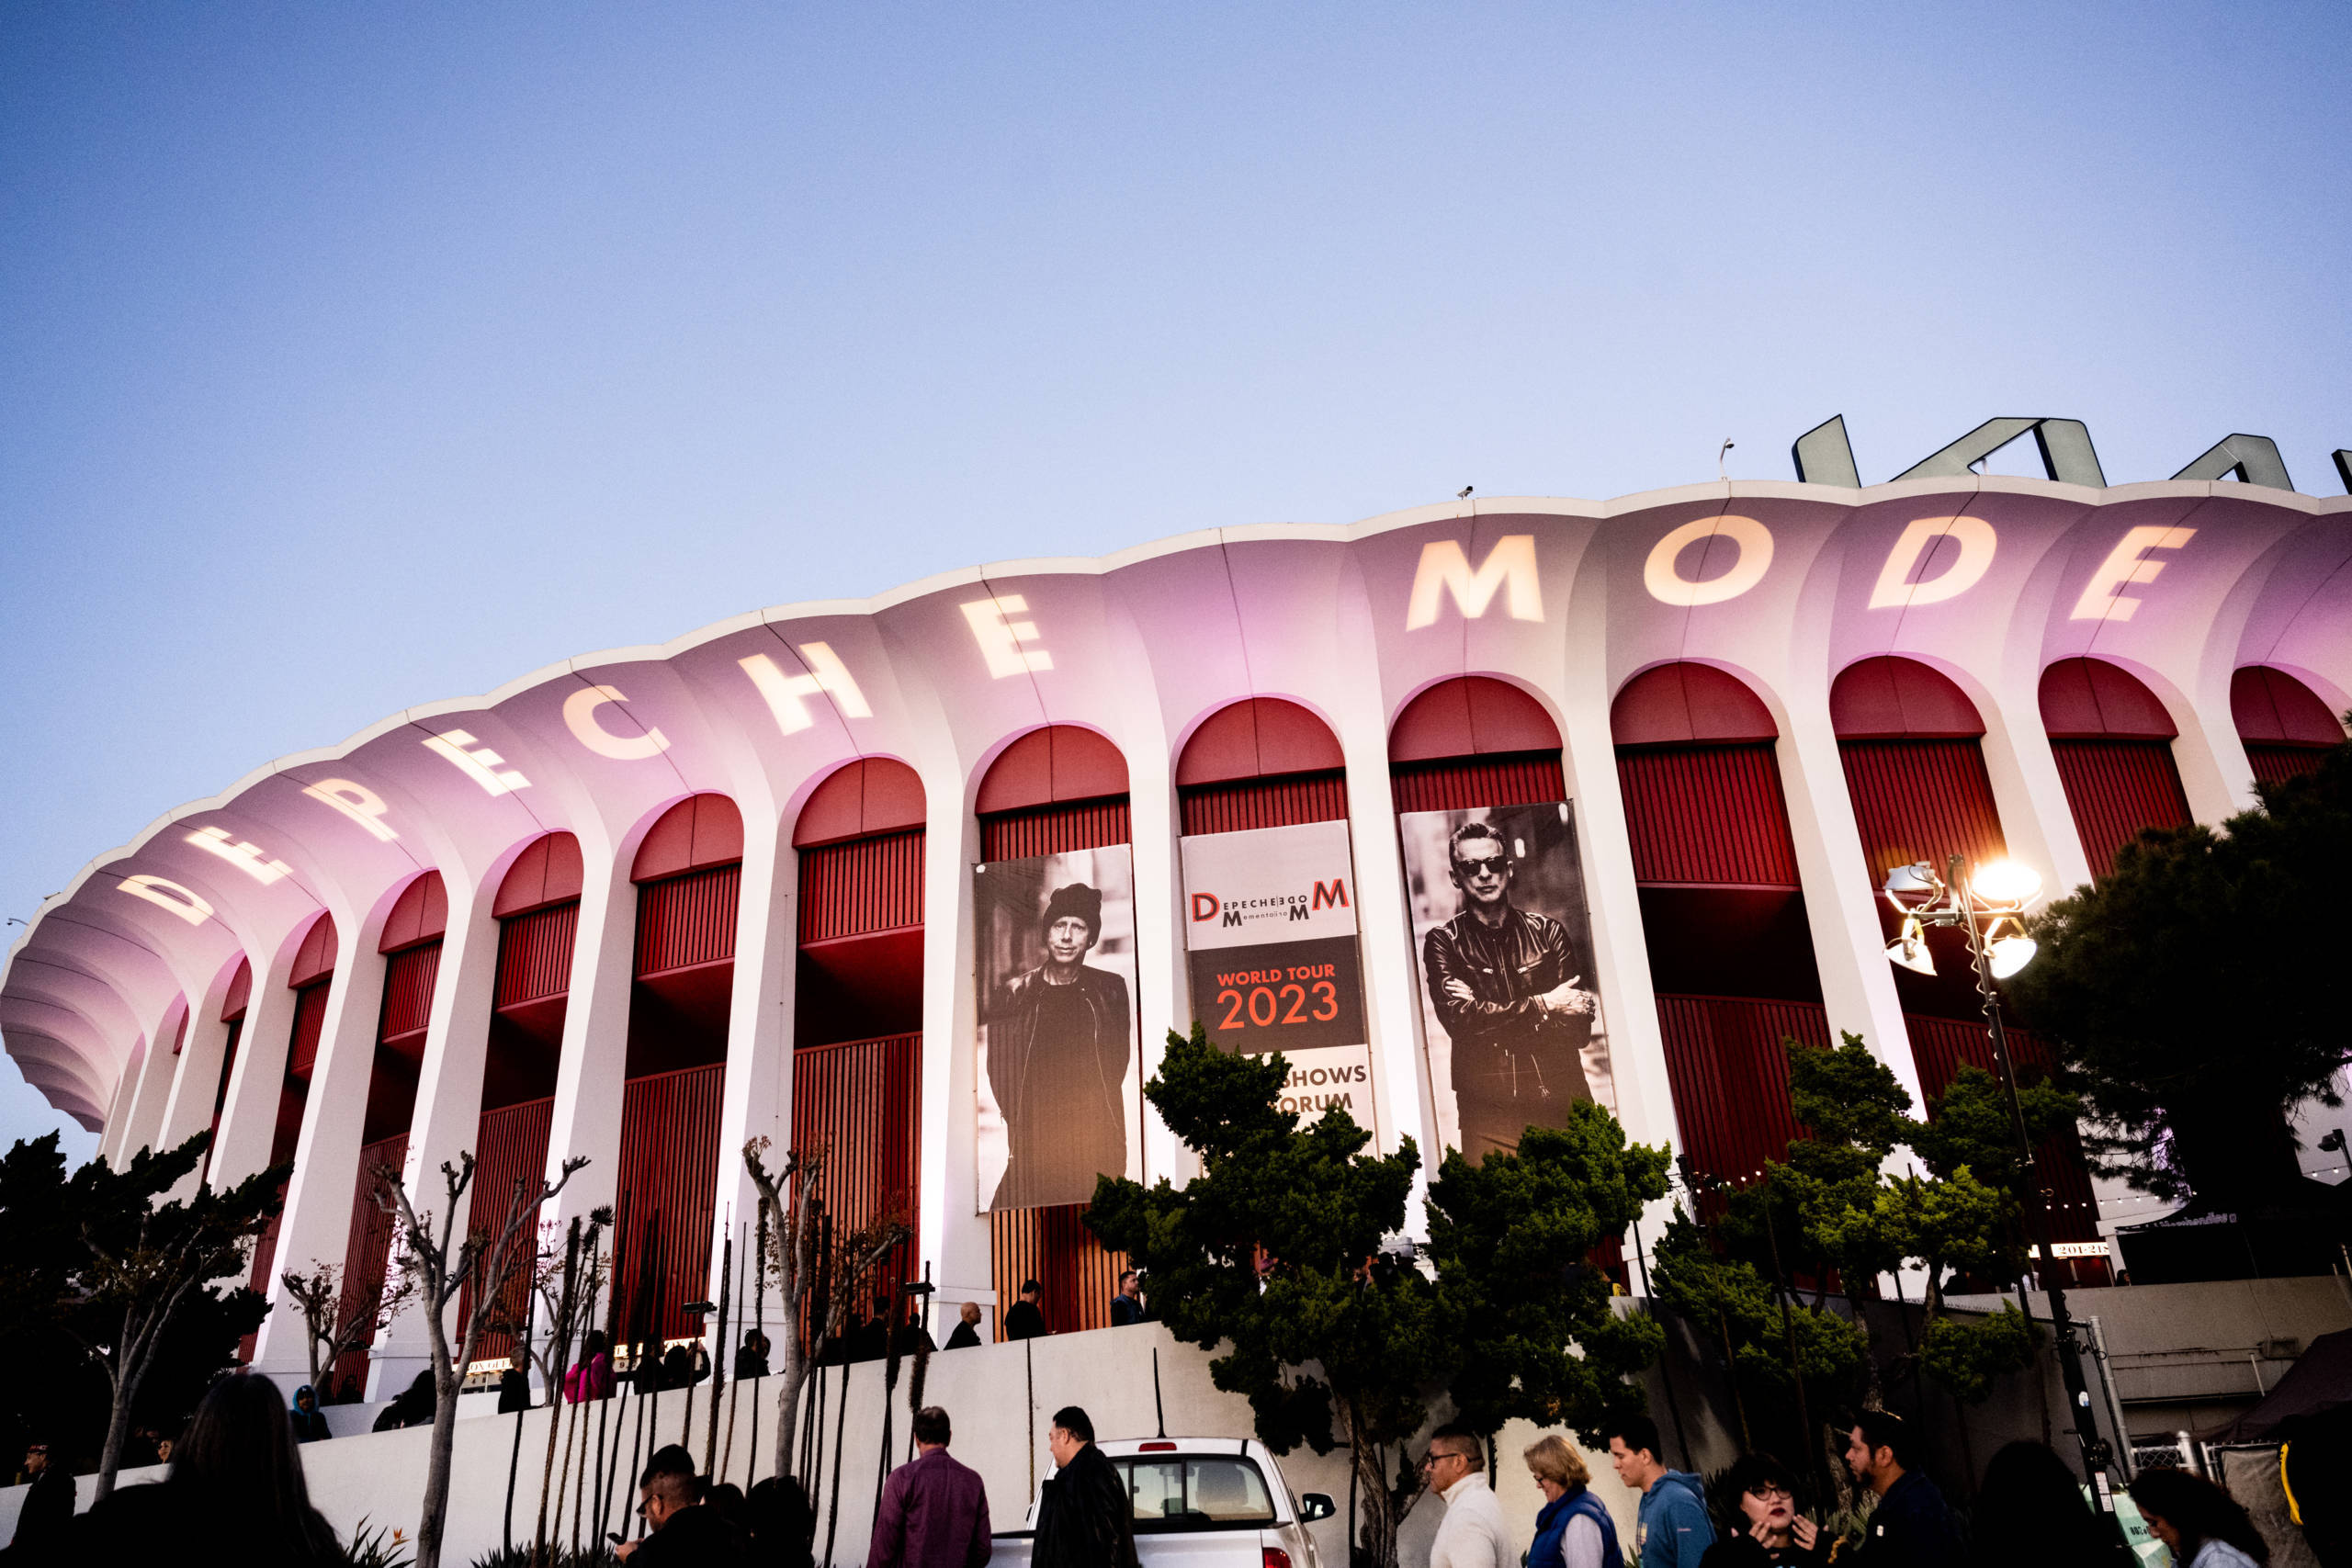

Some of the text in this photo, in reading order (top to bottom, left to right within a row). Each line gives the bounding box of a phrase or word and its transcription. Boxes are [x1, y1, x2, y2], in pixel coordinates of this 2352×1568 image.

[117, 514, 2199, 927] DEPECHE MODE
[1192, 892, 1276, 923] DEPECHE
[1223, 911, 1273, 928] Memento
[1216, 964, 1336, 987] WORLD TOUR
[1216, 981, 1339, 1030] 2023
[1279, 1092, 1353, 1112] ORUM
